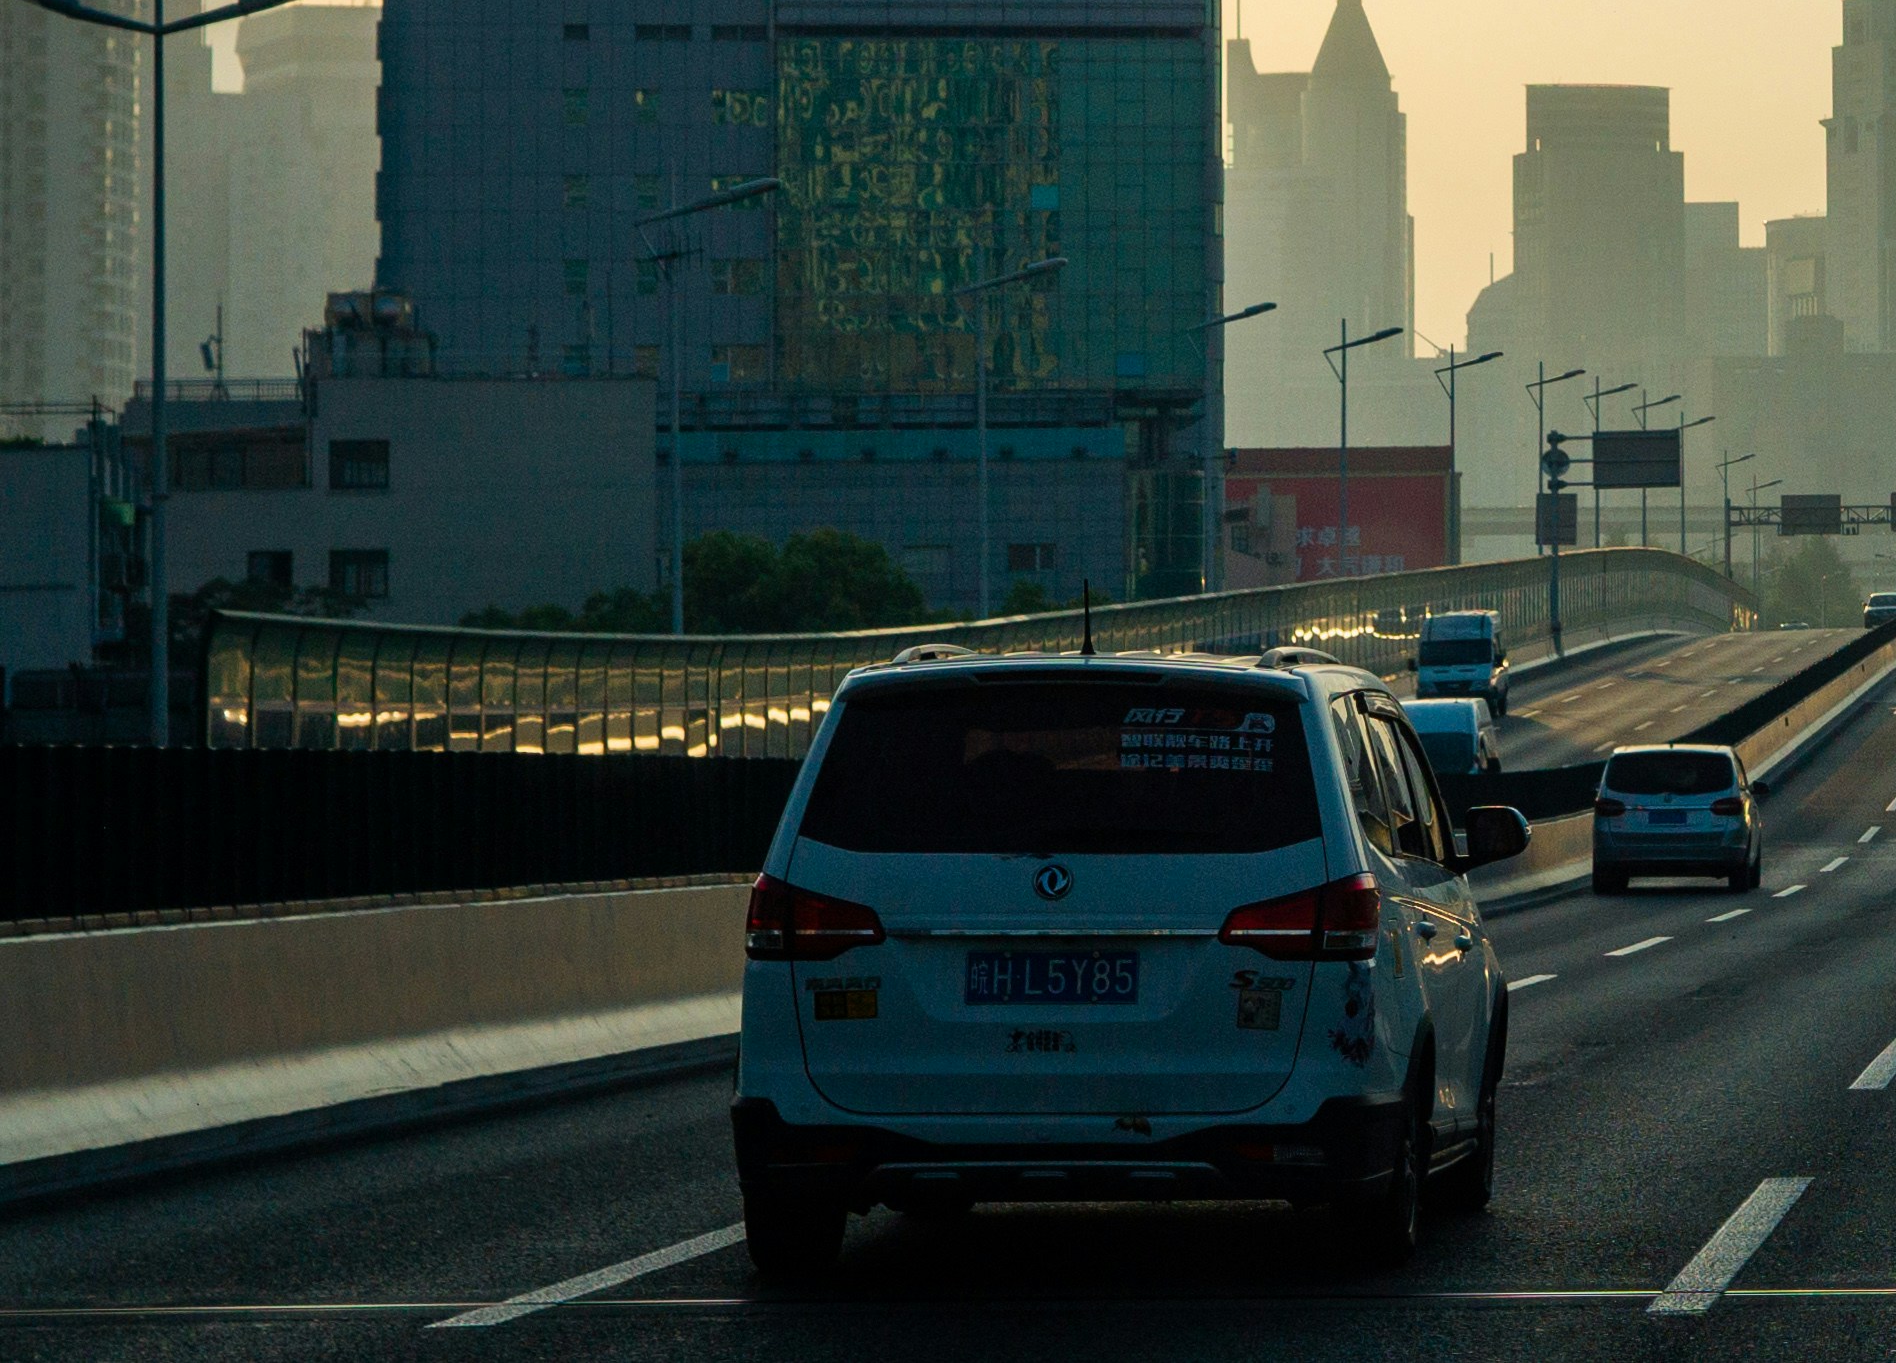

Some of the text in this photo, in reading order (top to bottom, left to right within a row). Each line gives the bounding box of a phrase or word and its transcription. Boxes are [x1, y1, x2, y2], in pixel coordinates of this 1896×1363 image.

[1122, 707, 1186, 724] 风行
[1120, 732, 1274, 752] 智联靓车路上开
